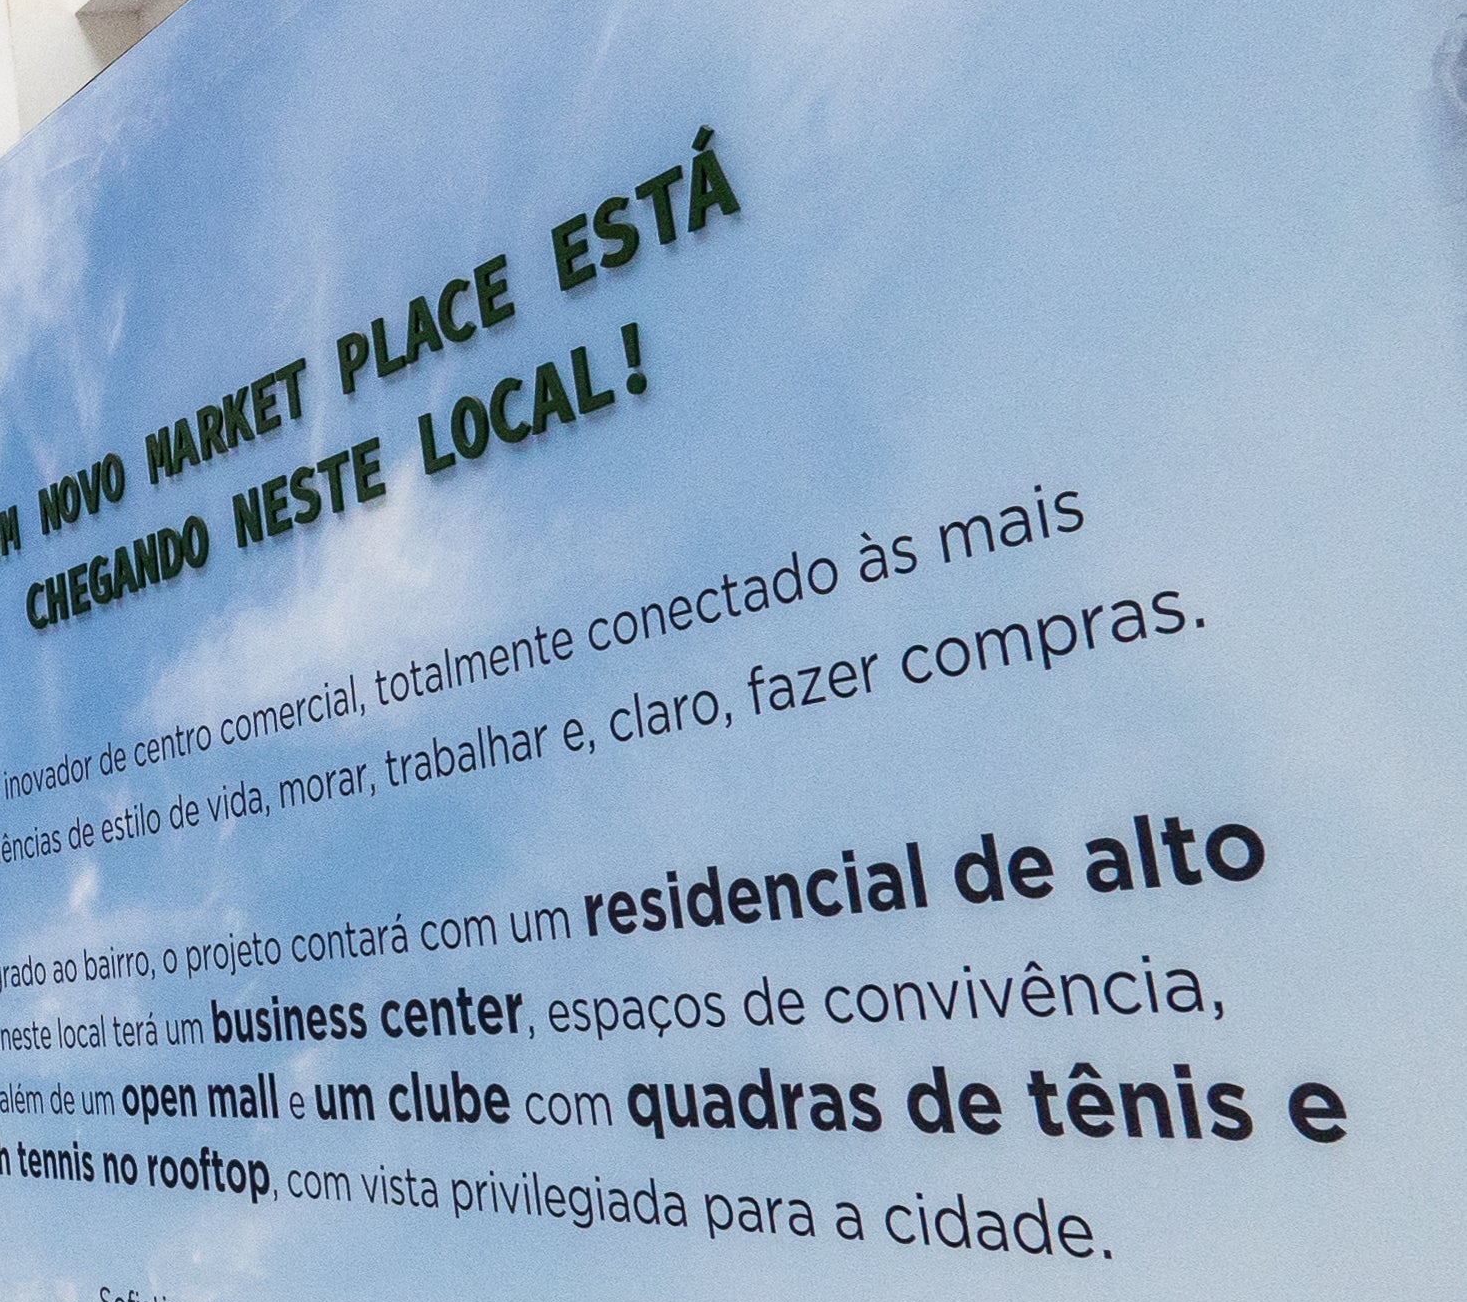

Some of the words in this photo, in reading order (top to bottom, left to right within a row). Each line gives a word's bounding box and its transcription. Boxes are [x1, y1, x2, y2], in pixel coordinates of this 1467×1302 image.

[38, 453, 126, 537] NOVO
[145, 358, 307, 486] MARKET
[337, 254, 516, 399] PLACE
[551, 125, 742, 298] ESTÁ
[26, 515, 210, 635] CHEGANDO
[232, 437, 386, 552] NESTE
[418, 322, 649, 480] LOCAL!
[5, 755, 92, 799] inovador
[100, 742, 126, 775] de
[134, 726, 211, 767] centro
[221, 675, 365, 745] comercial,
[375, 626, 573, 705] totalmente
[588, 551, 838, 651] conectado
[860, 532, 917, 583] às
[939, 484, 1084, 563] mais
[69, 818, 94, 849] de
[102, 803, 161, 843] estilo
[170, 795, 199, 829] de
[207, 781, 270, 821] vida,
[280, 764, 375, 808] morar,
[385, 725, 547, 786] trabalhar
[563, 719, 595, 754] e,
[610, 690, 732, 742] claro,
[747, 653, 878, 715] fazer
[901, 591, 1205, 684] compras.
[1, 1023, 51, 1050] neste
[58, 1016, 106, 1048] local
[113, 1012, 158, 1047] terá
[166, 1018, 204, 1045] um
[211, 995, 367, 1044] business
[381, 987, 534, 1039] center,
[548, 992, 726, 1040] espaços
[744, 976, 805, 1026] de
[825, 956, 1226, 1025] convivência,
[54, 959, 77, 983] ao
[84, 950, 155, 980] bairro,
[186, 933, 281, 978] projeto
[292, 913, 408, 962] contará
[421, 915, 497, 951] com
[510, 907, 571, 943] um
[584, 841, 928, 937] residencial
[954, 833, 1054, 904] de
[1085, 814, 1265, 893] alto
[0, 1083, 44, 1114] além
[50, 1083, 75, 1115] de
[82, 1091, 115, 1115] um
[122, 1084, 197, 1125] open
[207, 1072, 279, 1119] mall
[315, 1084, 375, 1121] um
[389, 1070, 510, 1124] clube
[525, 1092, 612, 1126] com
[627, 1067, 882, 1140] quadras
[907, 1066, 1002, 1136] de
[1027, 1062, 1253, 1141] tênis
[1288, 1082, 1347, 1144] e
[17, 1141, 95, 1182] tennis
[103, 1152, 138, 1185] no
[147, 1146, 277, 1204] rooftop,
[288, 1170, 351, 1201] com
[361, 1165, 439, 1208] vista
[451, 1170, 688, 1229] privilegiada
[705, 1194, 815, 1239] para
[885, 1192, 1112, 1260] cidade.
